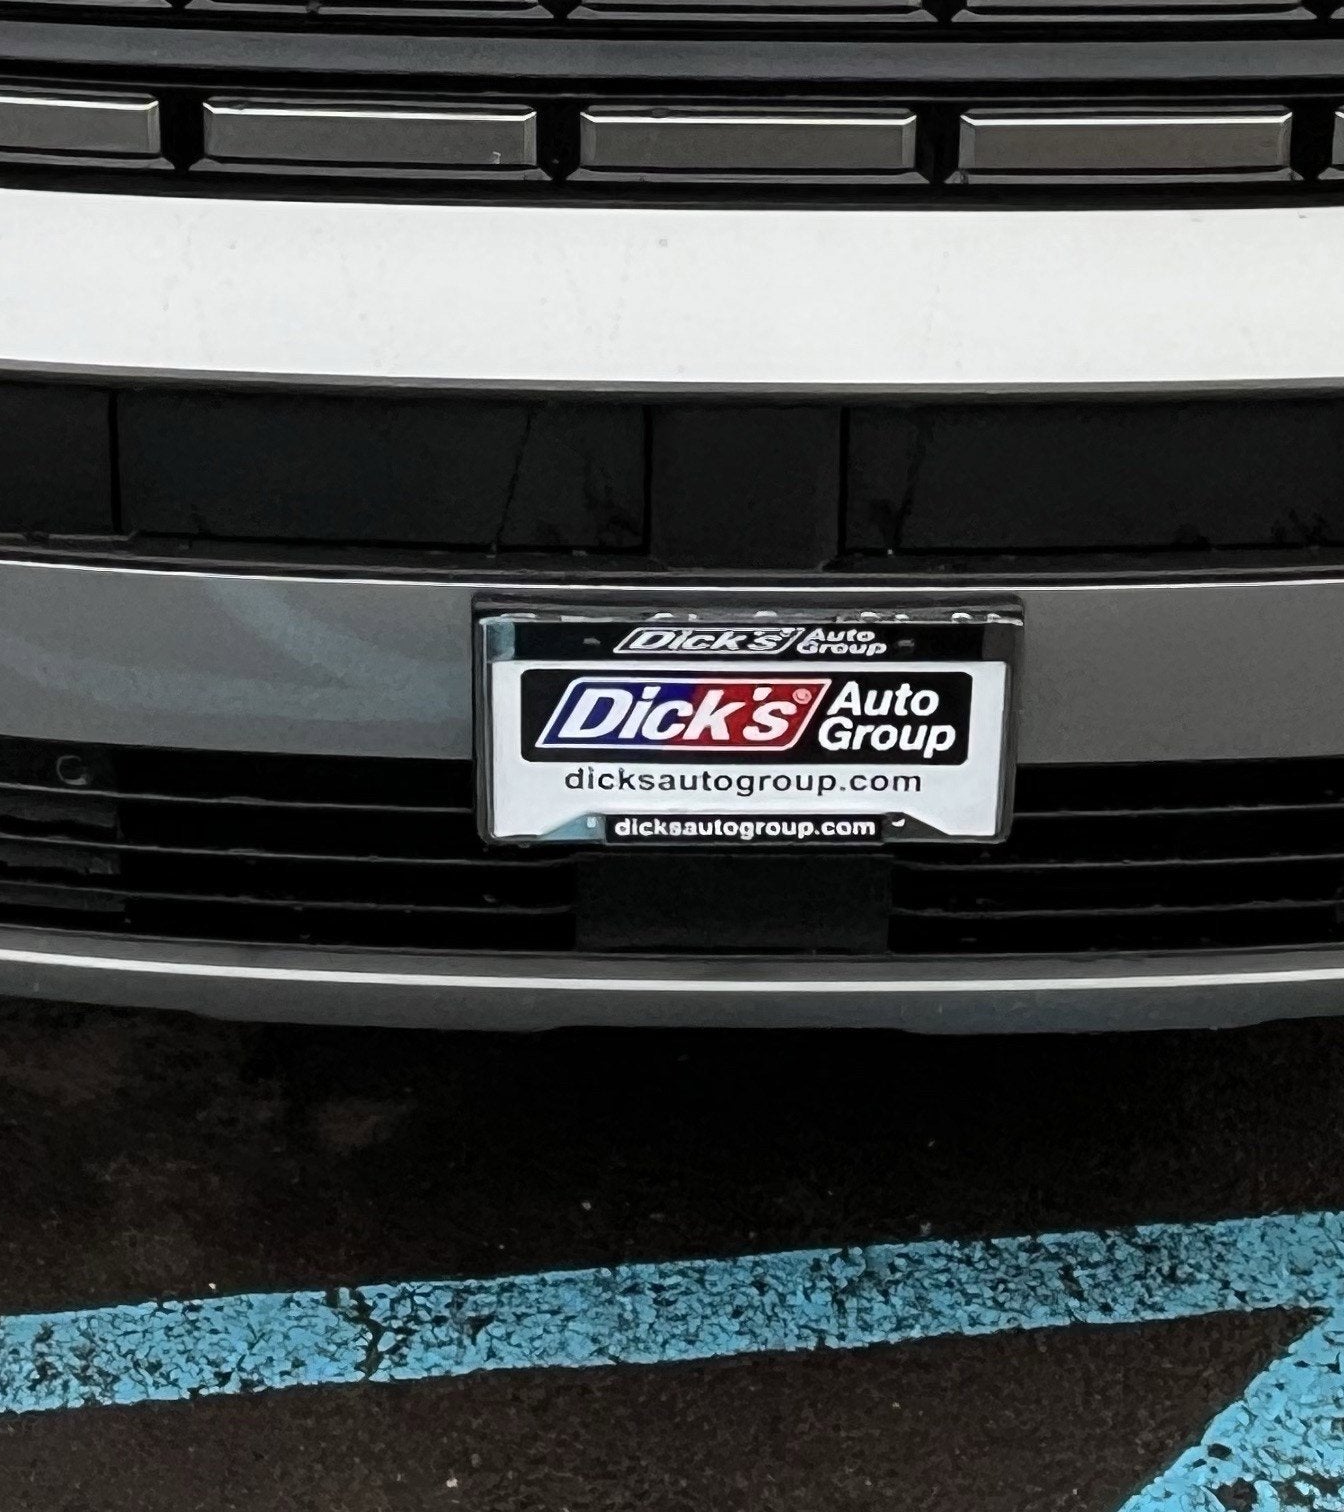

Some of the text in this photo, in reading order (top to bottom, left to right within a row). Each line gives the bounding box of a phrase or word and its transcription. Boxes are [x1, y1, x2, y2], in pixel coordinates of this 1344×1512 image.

[628, 629, 784, 652] Dick's
[796, 639, 888, 657] Group
[803, 628, 876, 643] Auto
[557, 683, 798, 742] Dick's
[825, 680, 939, 718] Auto
[817, 716, 957, 759] Group
[564, 766, 922, 797] dicksautogroup.com
[613, 817, 877, 841] dicksautogroup.com
